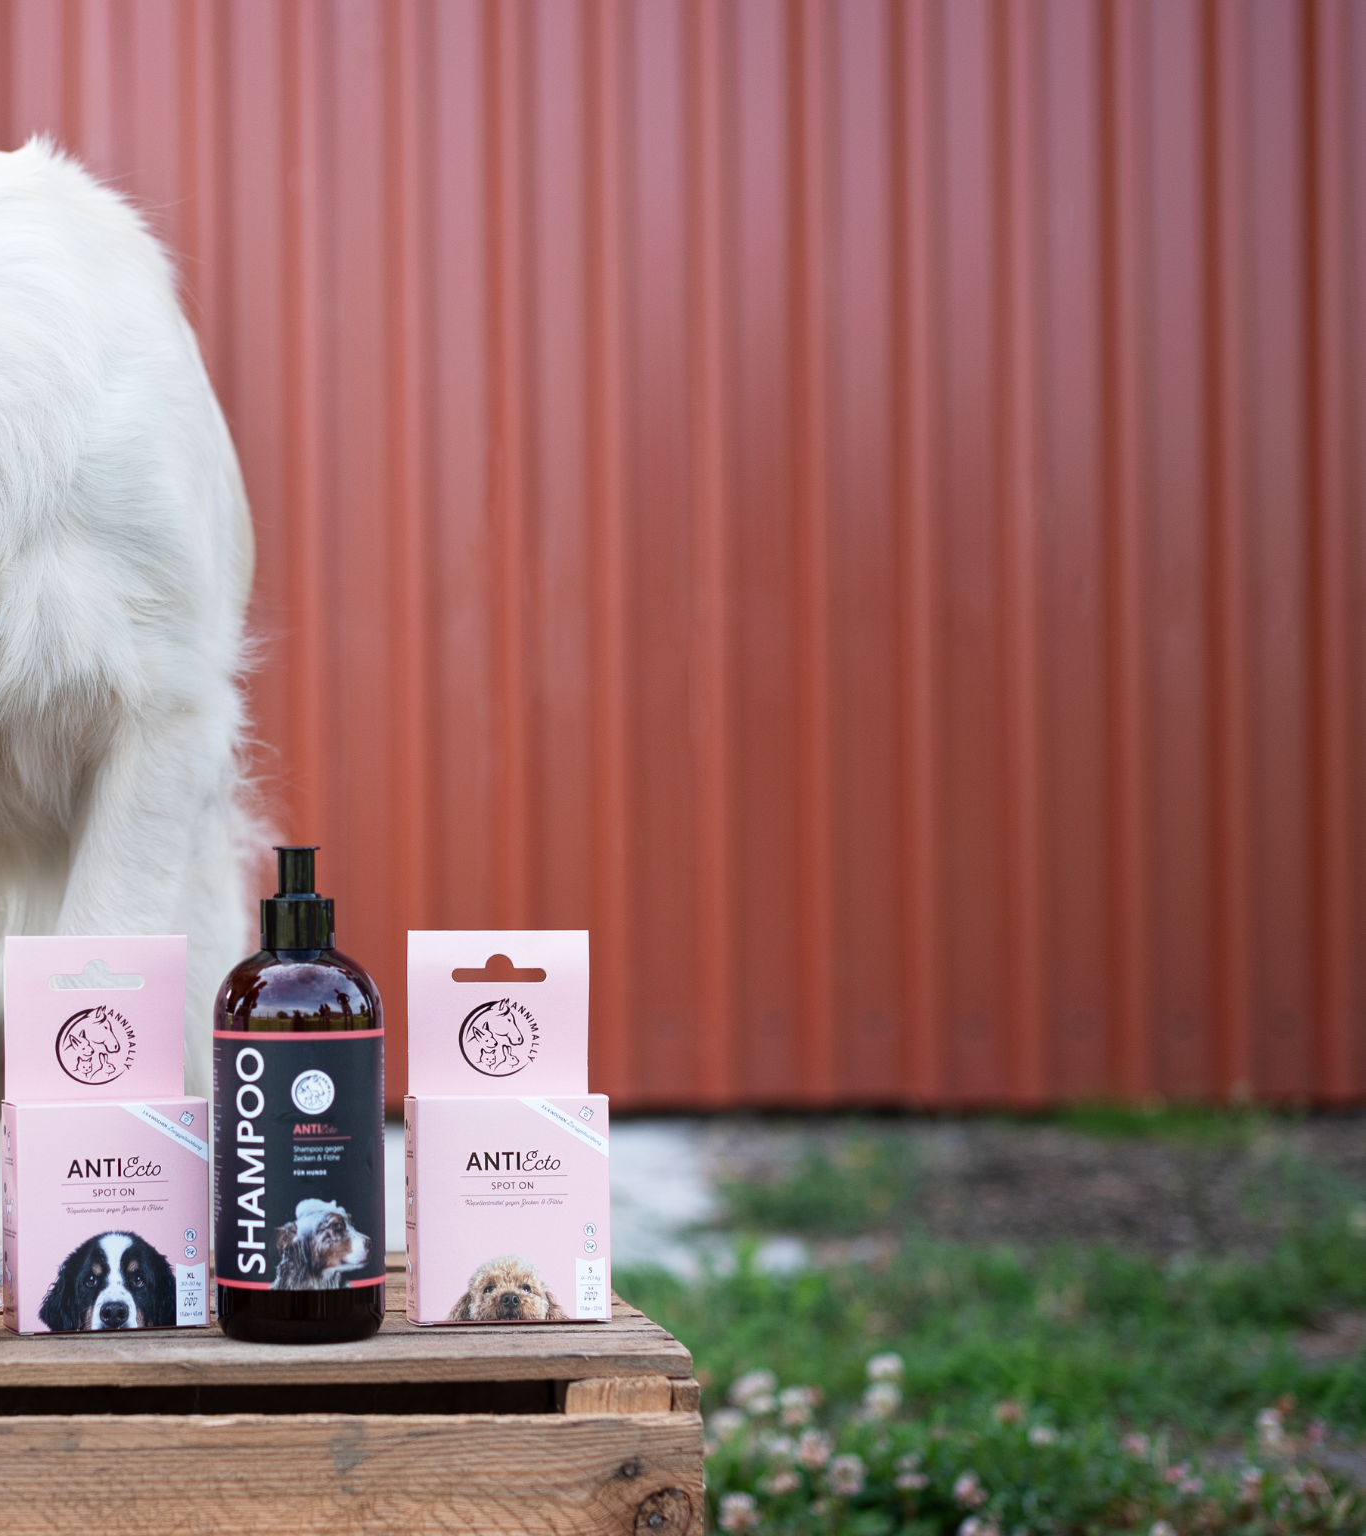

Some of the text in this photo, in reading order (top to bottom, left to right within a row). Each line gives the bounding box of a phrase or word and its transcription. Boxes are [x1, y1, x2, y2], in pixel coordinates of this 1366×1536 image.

[511, 1001, 540, 1062] ANNIMALLY
[107, 1008, 136, 1070] ANNIMALLY
[293, 1145, 345, 1154] Shampoo gegen
[235, 1047, 267, 1274] SHAMPOO
[293, 1153, 341, 1162] Zecken & Flöhe
[293, 1168, 305, 1176] FÜR
[491, 1181, 534, 1190] SPOT ON
[92, 1187, 135, 1197] SPOT ON
[519, 1198, 540, 1208] Zecken
[106, 1207, 121, 1215] gegen
[121, 1205, 140, 1215] Zecken
